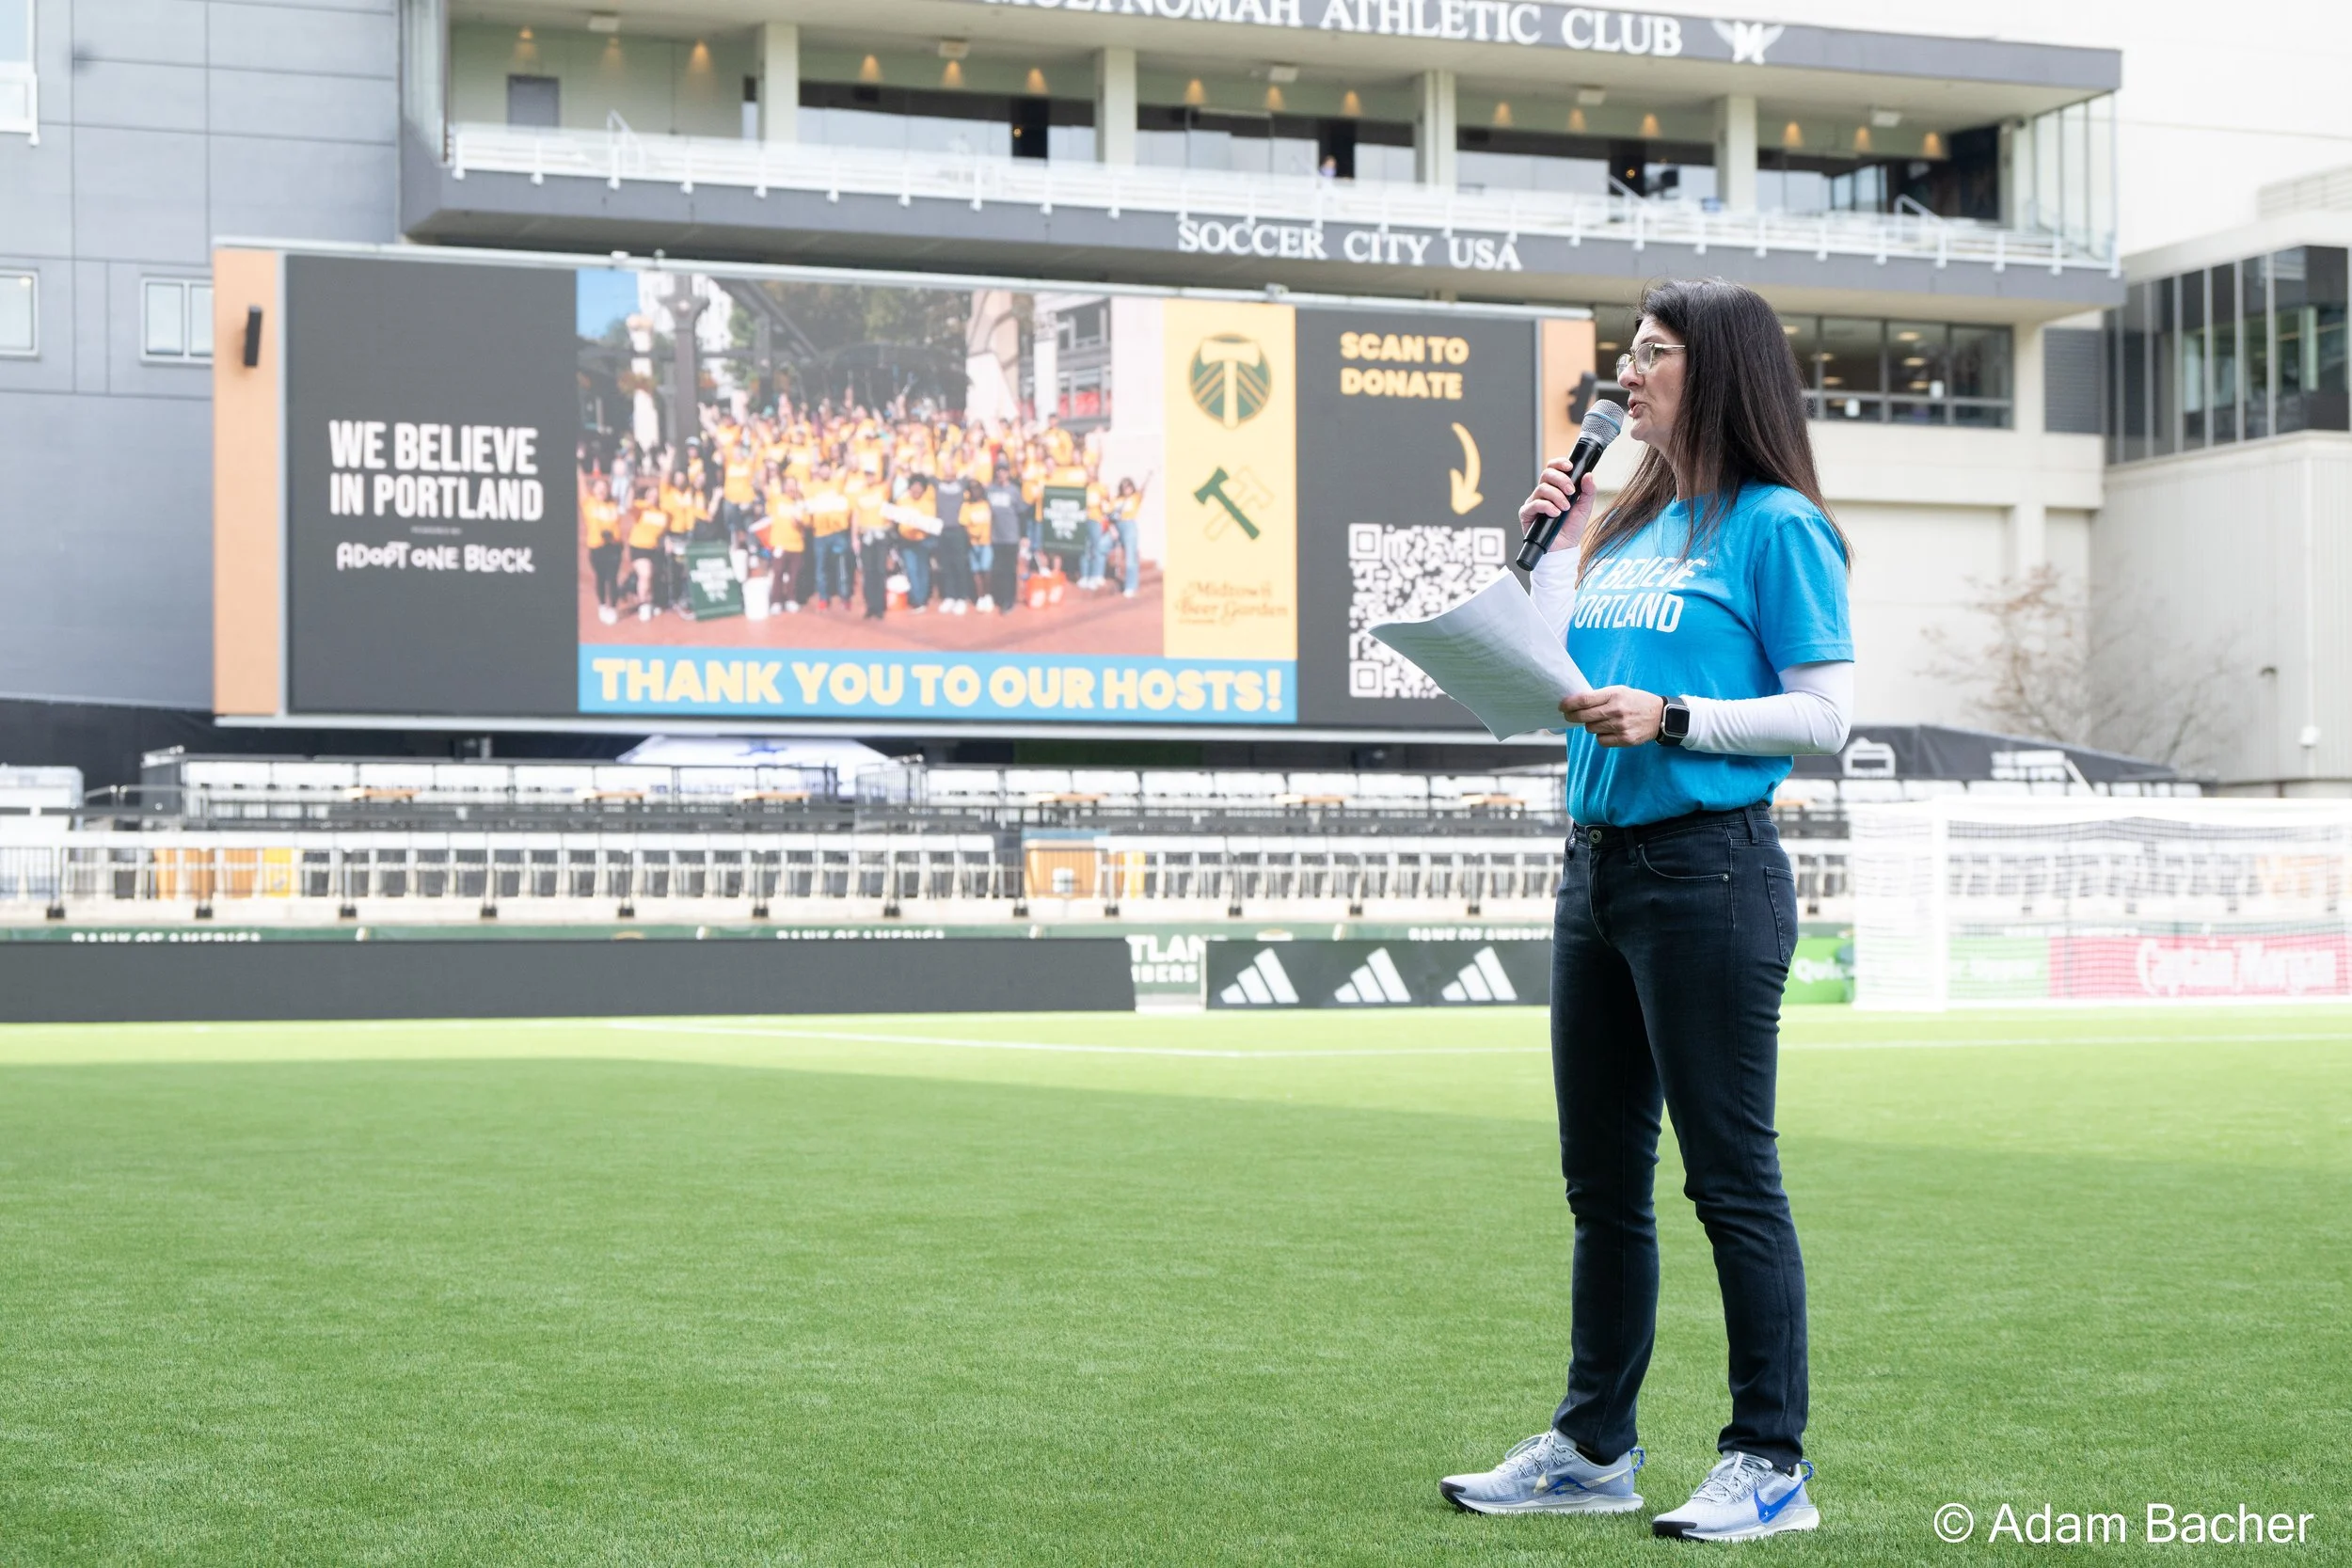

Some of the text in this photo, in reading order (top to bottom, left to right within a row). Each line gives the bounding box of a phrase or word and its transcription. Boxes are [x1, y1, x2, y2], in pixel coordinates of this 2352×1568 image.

[1319, 0, 1543, 45] ATHLETIC
[1561, 8, 1683, 56] CLUB
[1177, 220, 1522, 271] SOCCER CITY USA
[1340, 331, 1470, 365] SCAN TO
[1340, 367, 1464, 400] DONATE
[328, 420, 539, 475] WE BELIEVE
[329, 472, 545, 522] IN PORTLAND
[1597, 556, 1708, 590] BELIEVE
[592, 657, 1282, 712] THANK YOU TO OUR HOSTS!
[1125, 934, 1219, 962] TLAN
